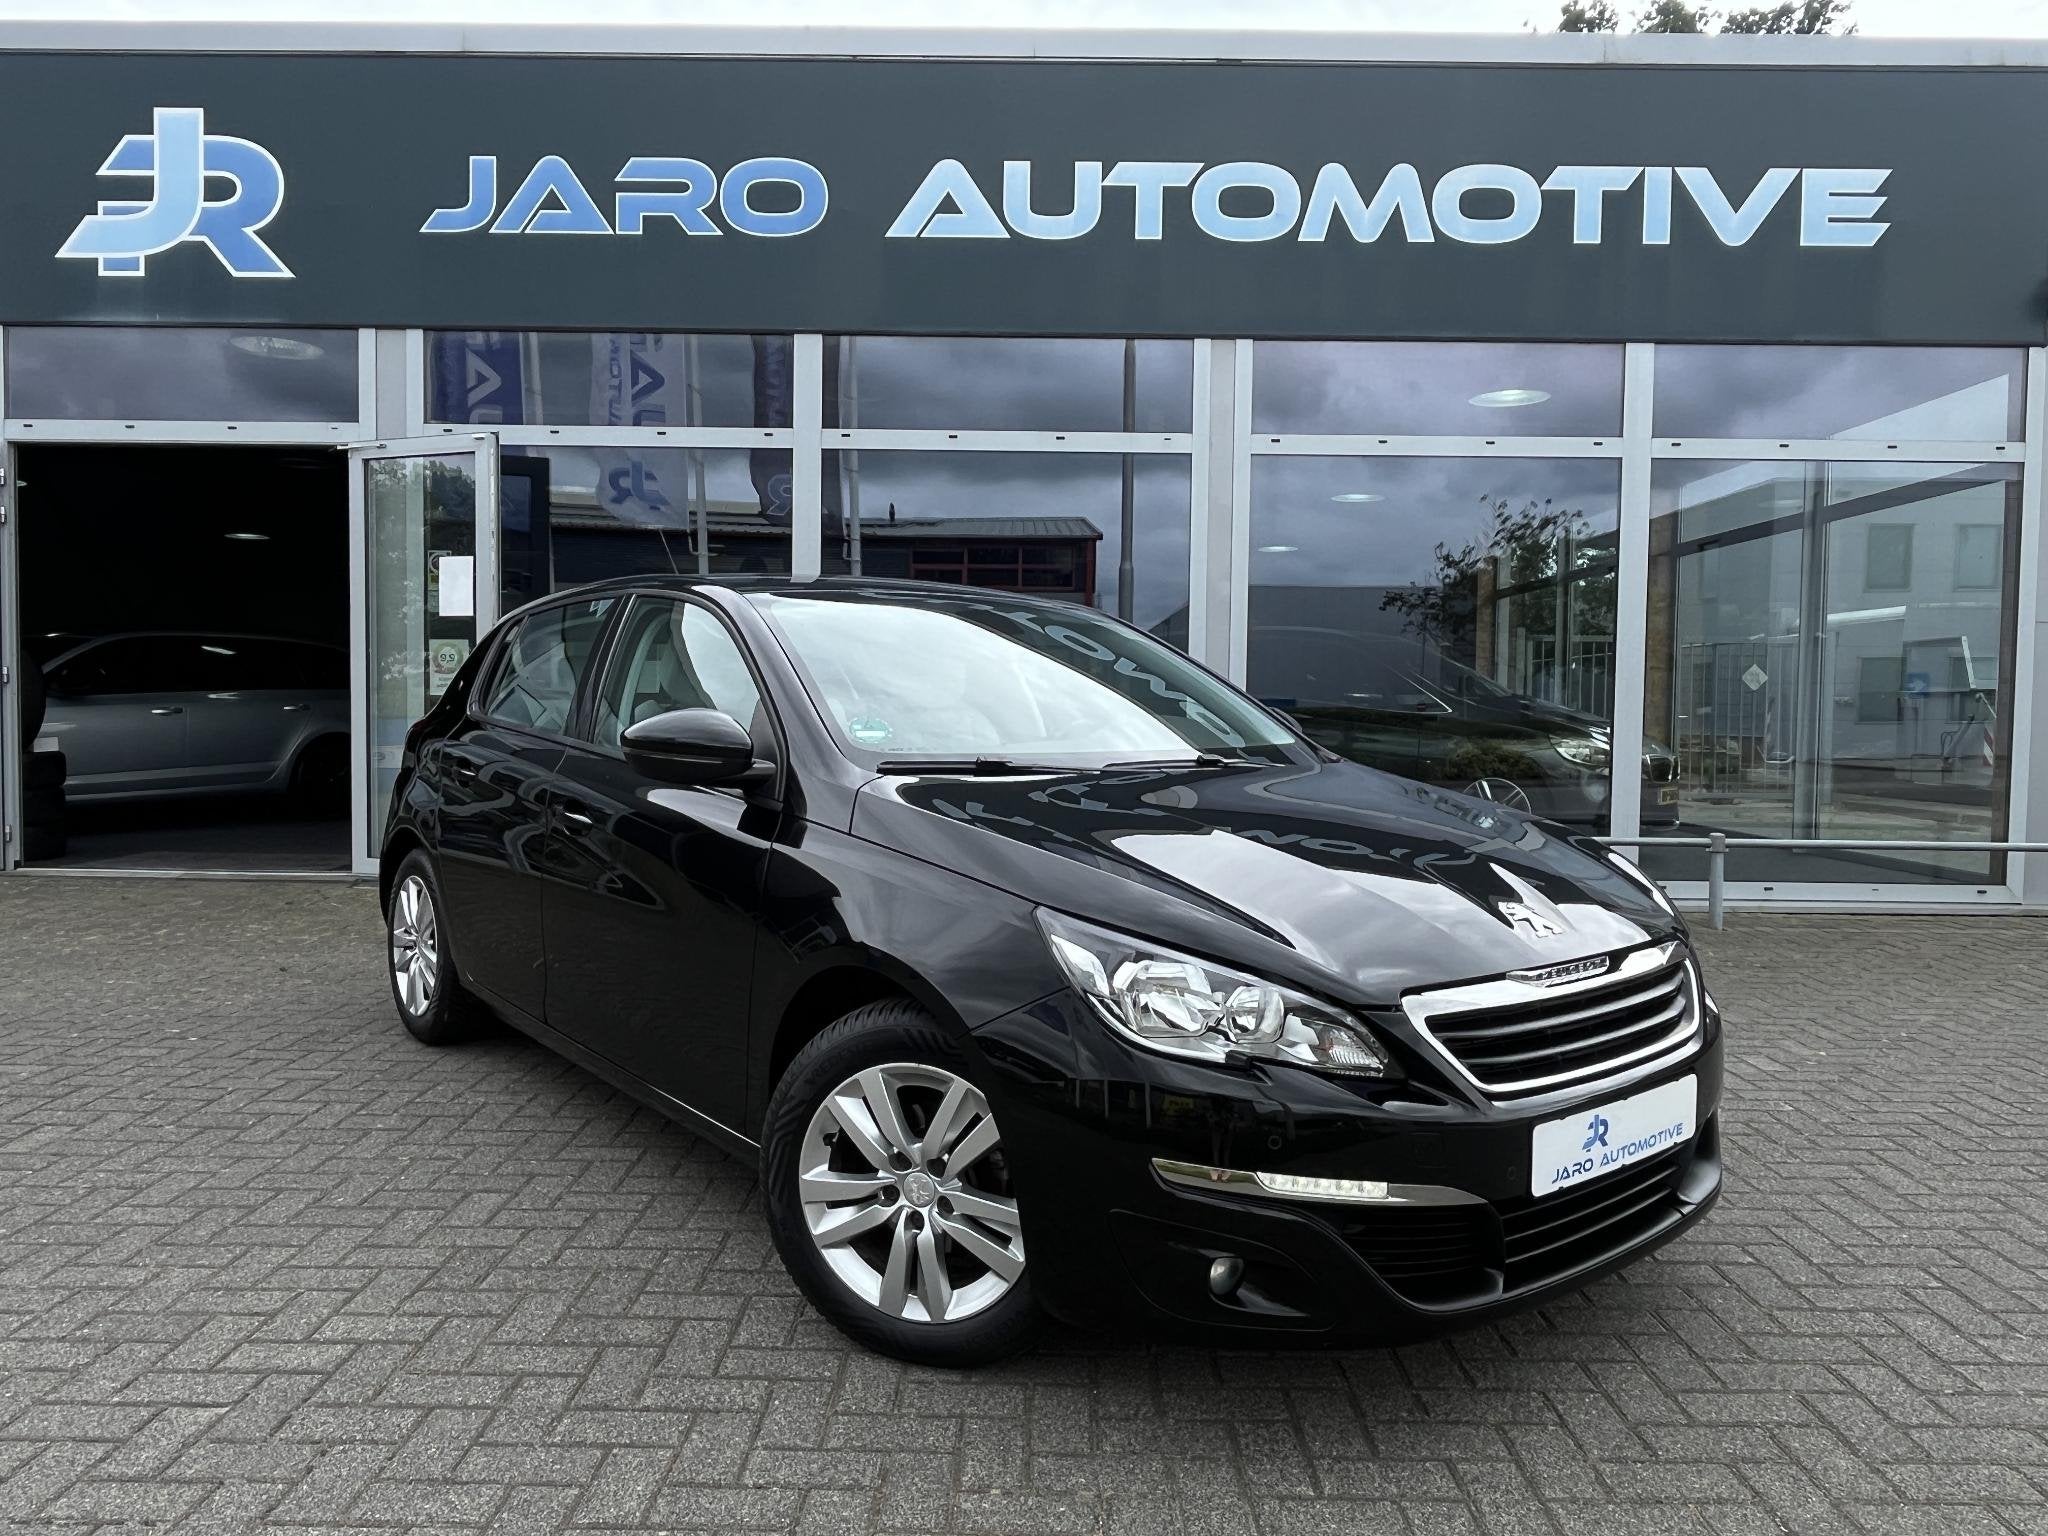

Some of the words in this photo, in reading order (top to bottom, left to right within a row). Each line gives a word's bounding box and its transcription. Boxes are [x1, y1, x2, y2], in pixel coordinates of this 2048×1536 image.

[419, 154, 829, 237] JARO
[885, 158, 1893, 247] AUTOMOTIVE
[1552, 1158, 1594, 1184] JARO
[1600, 1122, 1684, 1167] AUTOMOTIVE
